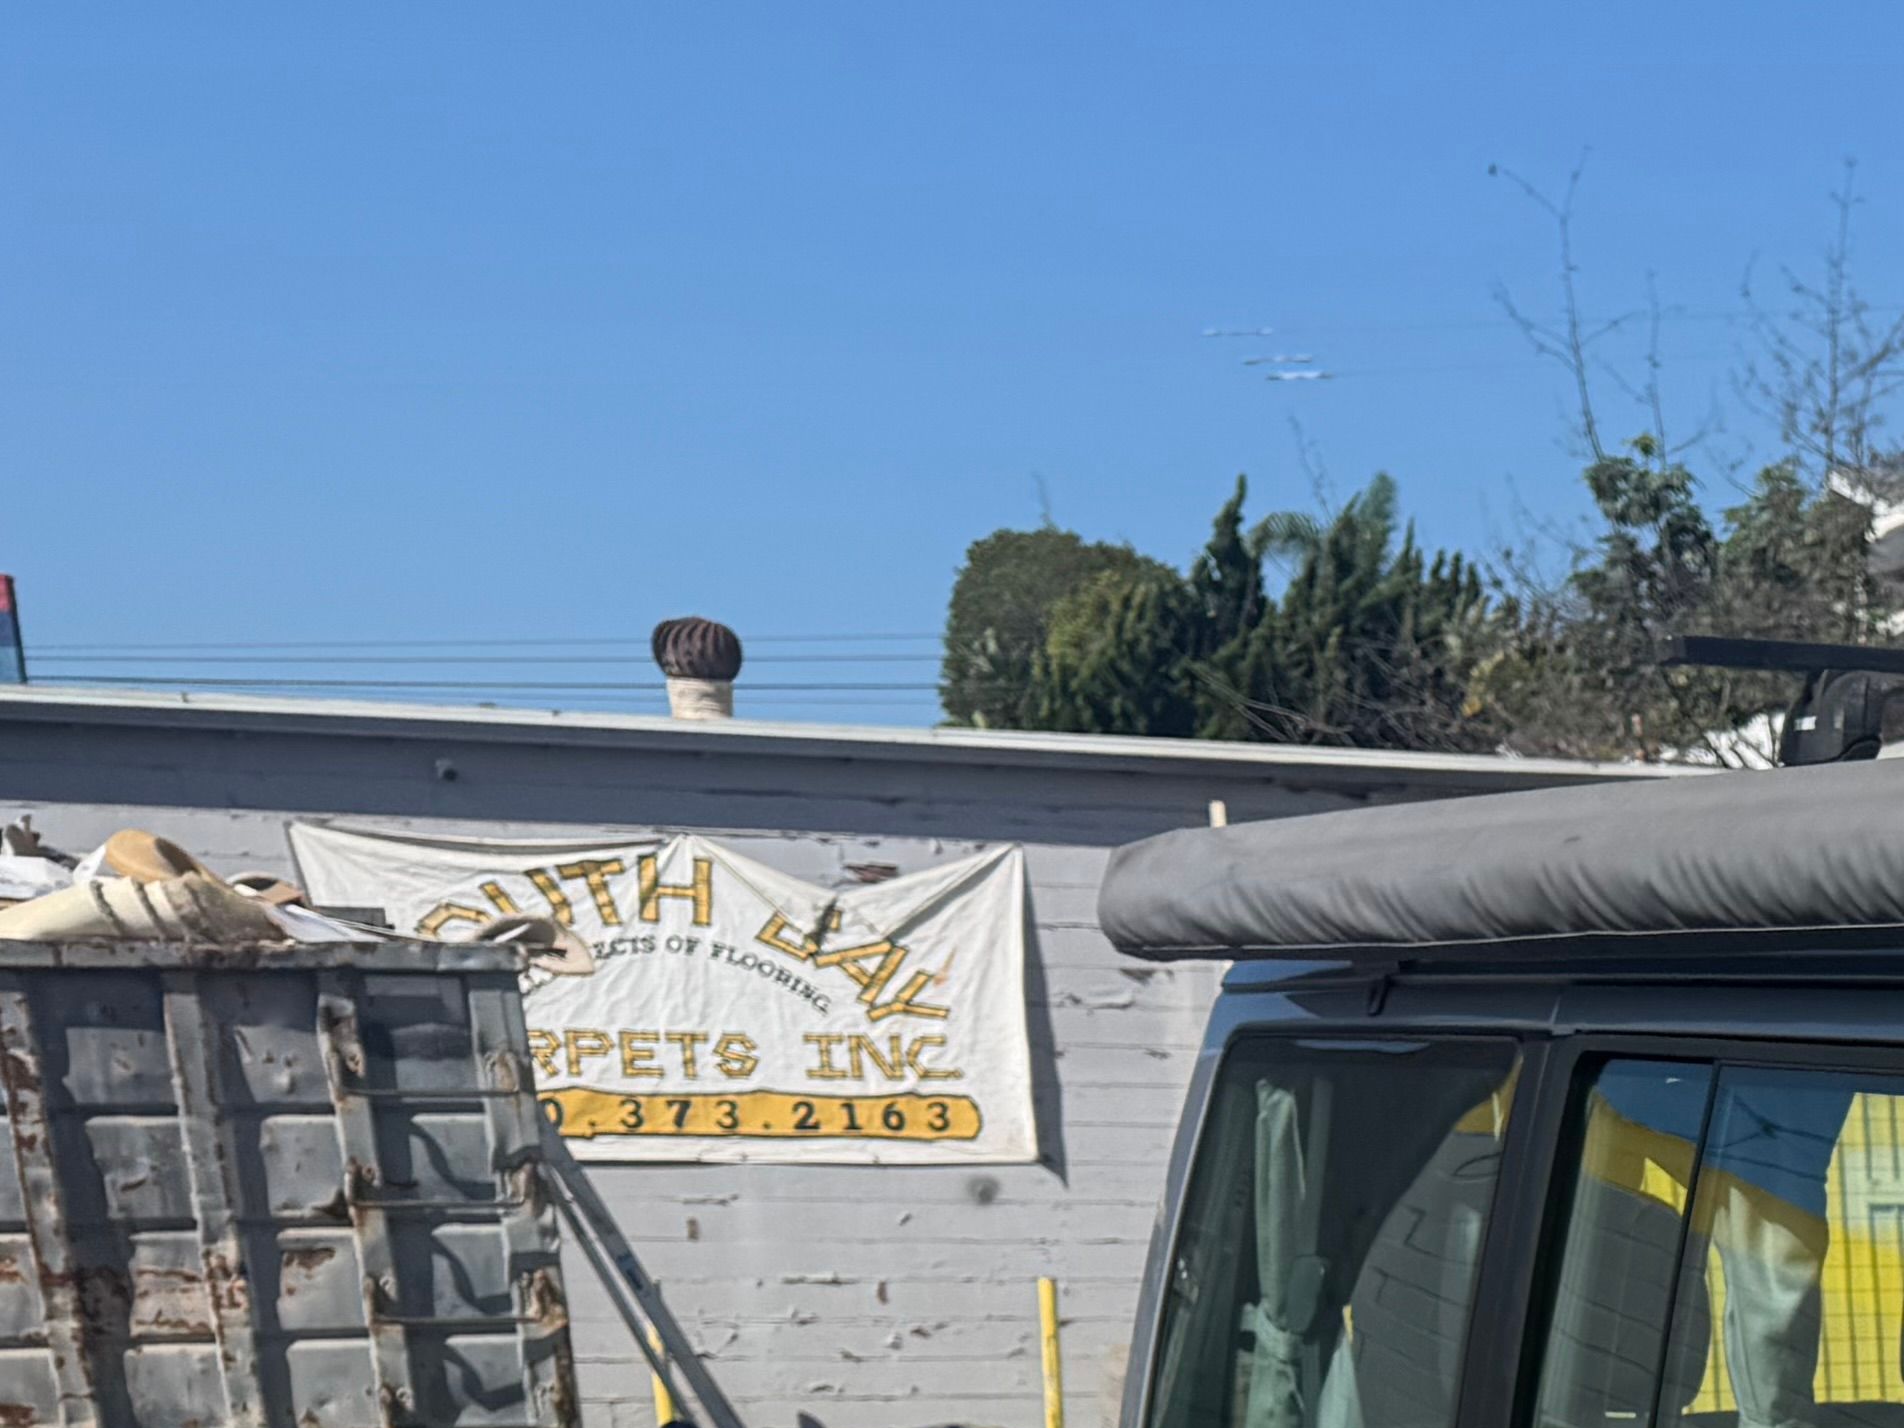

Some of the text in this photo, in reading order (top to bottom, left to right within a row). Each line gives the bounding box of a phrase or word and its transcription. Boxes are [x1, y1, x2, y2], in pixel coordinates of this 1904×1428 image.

[415, 853, 714, 939] OUTH
[665, 935, 700, 956] OF
[527, 1029, 758, 1079] RPETS
[540, 1098, 950, 1133] 0.373.2163
